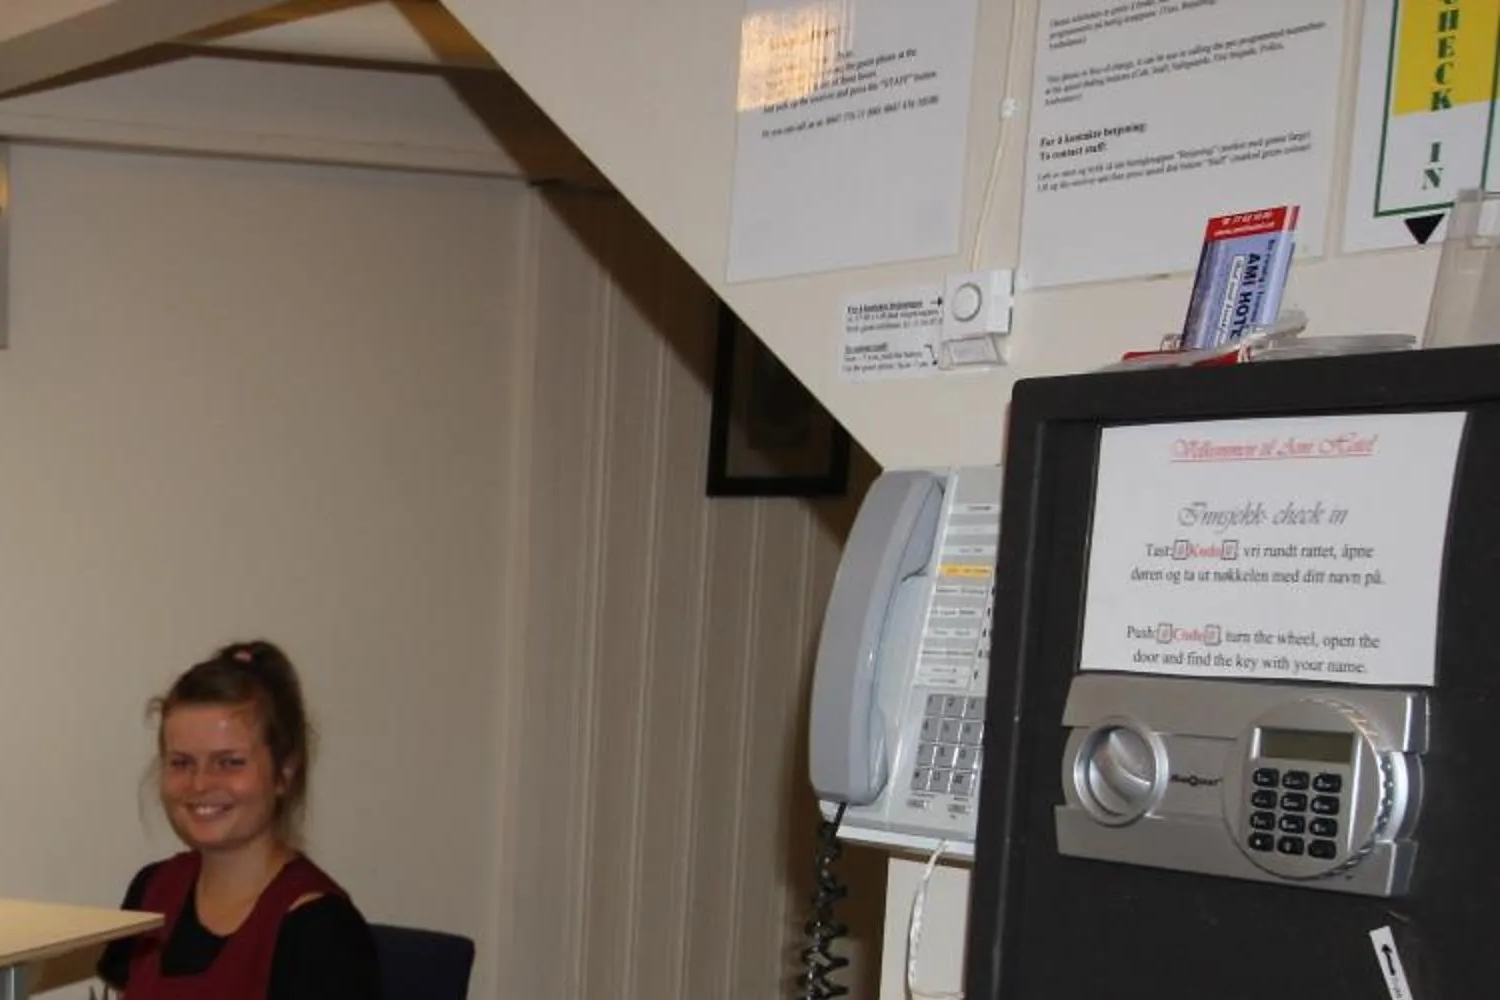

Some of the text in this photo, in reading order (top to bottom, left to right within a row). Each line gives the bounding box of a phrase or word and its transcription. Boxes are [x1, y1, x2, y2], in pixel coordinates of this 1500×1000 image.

[1430, 0, 1460, 112] HECK
[1421, 141, 1444, 190] IN
[1242, 253, 1261, 286] AMI
[1230, 291, 1253, 341] HOTE
[1263, 544, 1298, 557] rundt
[1165, 570, 1181, 584] og
[1271, 568, 1299, 582] med
[1254, 629, 1274, 645] the
[1323, 636, 1355, 651] open
[1359, 632, 1380, 649] the
